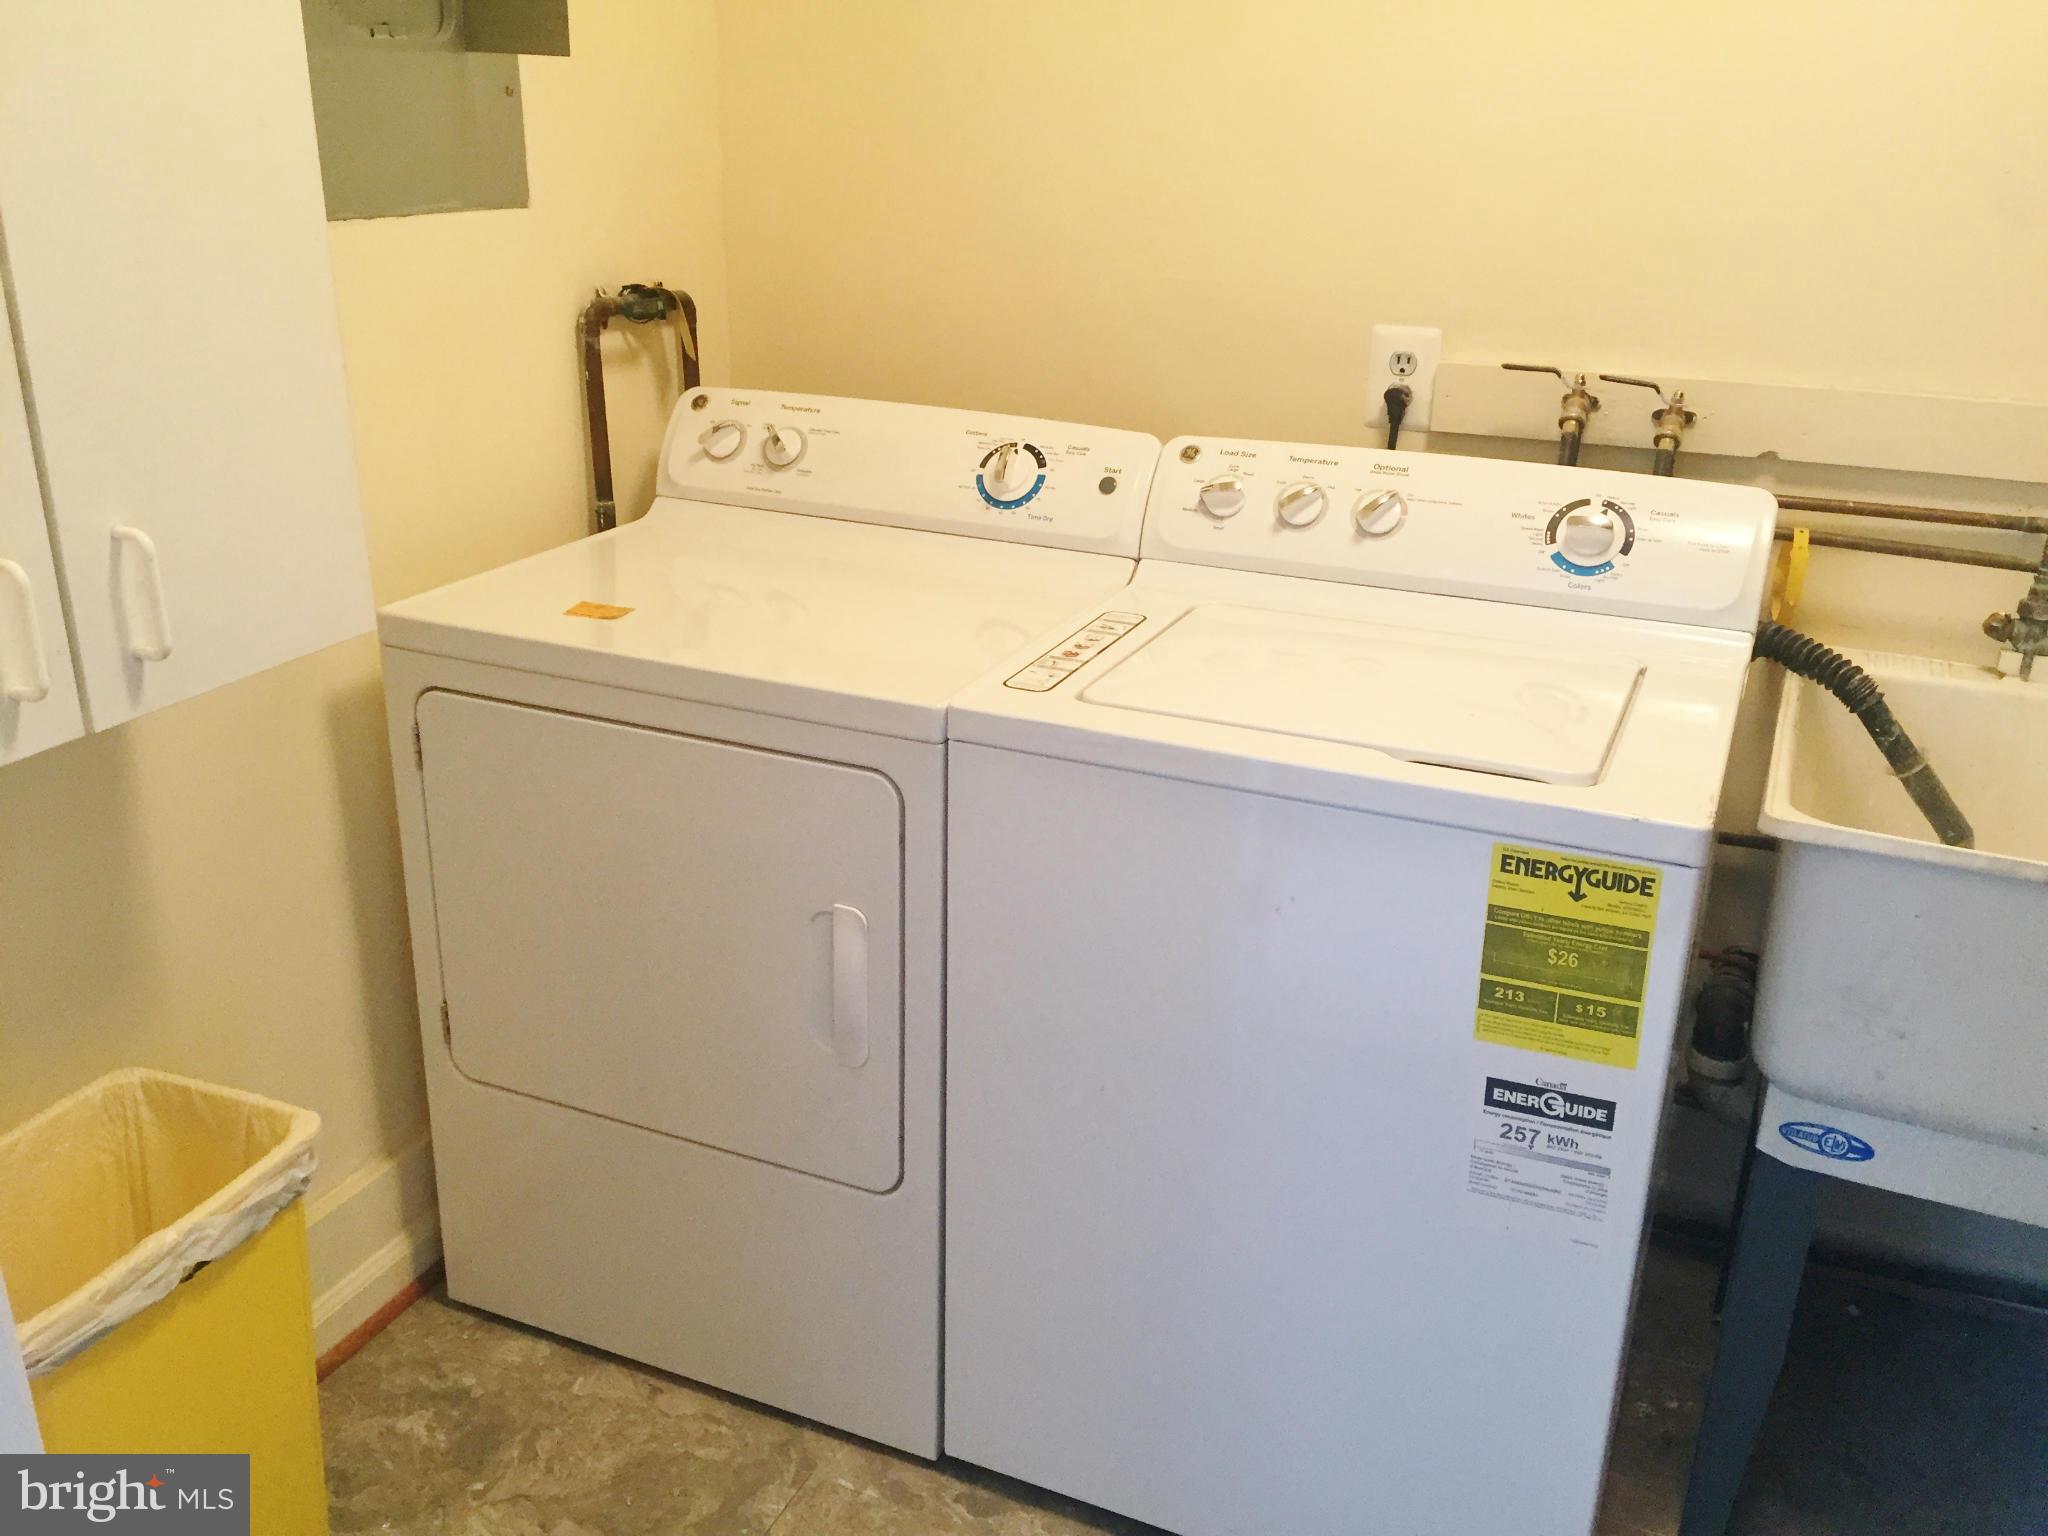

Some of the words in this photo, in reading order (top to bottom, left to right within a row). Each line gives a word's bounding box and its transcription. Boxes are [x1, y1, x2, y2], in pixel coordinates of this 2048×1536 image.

[781, 403, 821, 414] Temperature
[1219, 448, 1239, 457] Load
[1240, 451, 1257, 459] Size
[1288, 455, 1340, 467] Temperature
[1104, 466, 1122, 475] Start
[1373, 463, 1410, 473] Optional
[1027, 513, 1042, 521] Time
[1042, 515, 1054, 523] Dry
[1511, 511, 1536, 521] Whites
[1567, 581, 1592, 591] Colors
[1499, 853, 1657, 899] ENERGYGUIDE
[1547, 948, 1579, 968] $26
[1494, 986, 1525, 1003] 213
[1492, 1087, 1608, 1122] ENERGUIDE
[1483, 1109, 1501, 1118] Energy
[1499, 1122, 1541, 1145] 257
[1547, 1133, 1579, 1150] kWh
